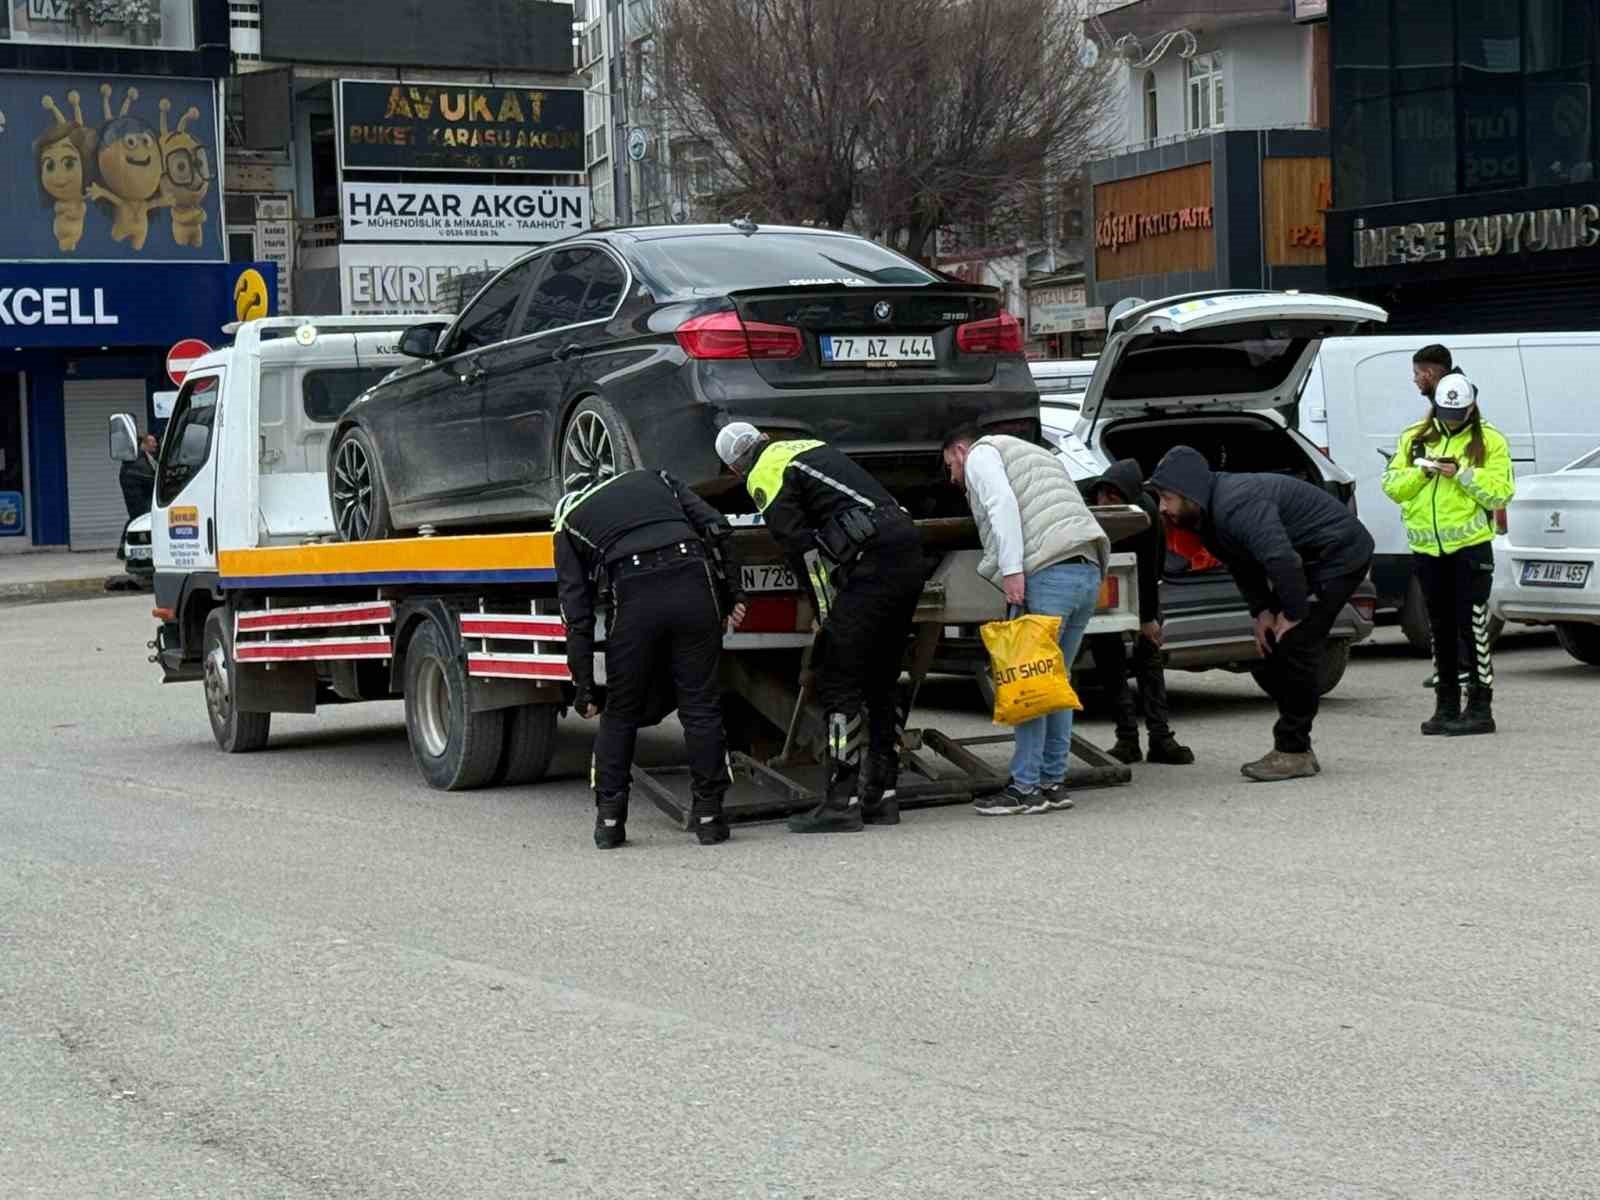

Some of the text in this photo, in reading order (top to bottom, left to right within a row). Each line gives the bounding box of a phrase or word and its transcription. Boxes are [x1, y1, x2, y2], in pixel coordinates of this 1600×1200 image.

[384, 86, 545, 122] AVUKAT
[349, 190, 582, 218] HAZAR AKGÜN
[367, 216, 442, 229] MÜHENDİSLİK
[444, 218, 452, 228] &
[453, 216, 506, 229] MİMARLIK
[516, 217, 566, 230] TAAHHÜT
[1095, 211, 1137, 252] KÖŞEM
[1453, 204, 1600, 259] KUYUMC
[833, 339, 932, 358] 77 AZ 444
[760, 567, 795, 588] 728
[1019, 659, 1055, 680] SHOP
